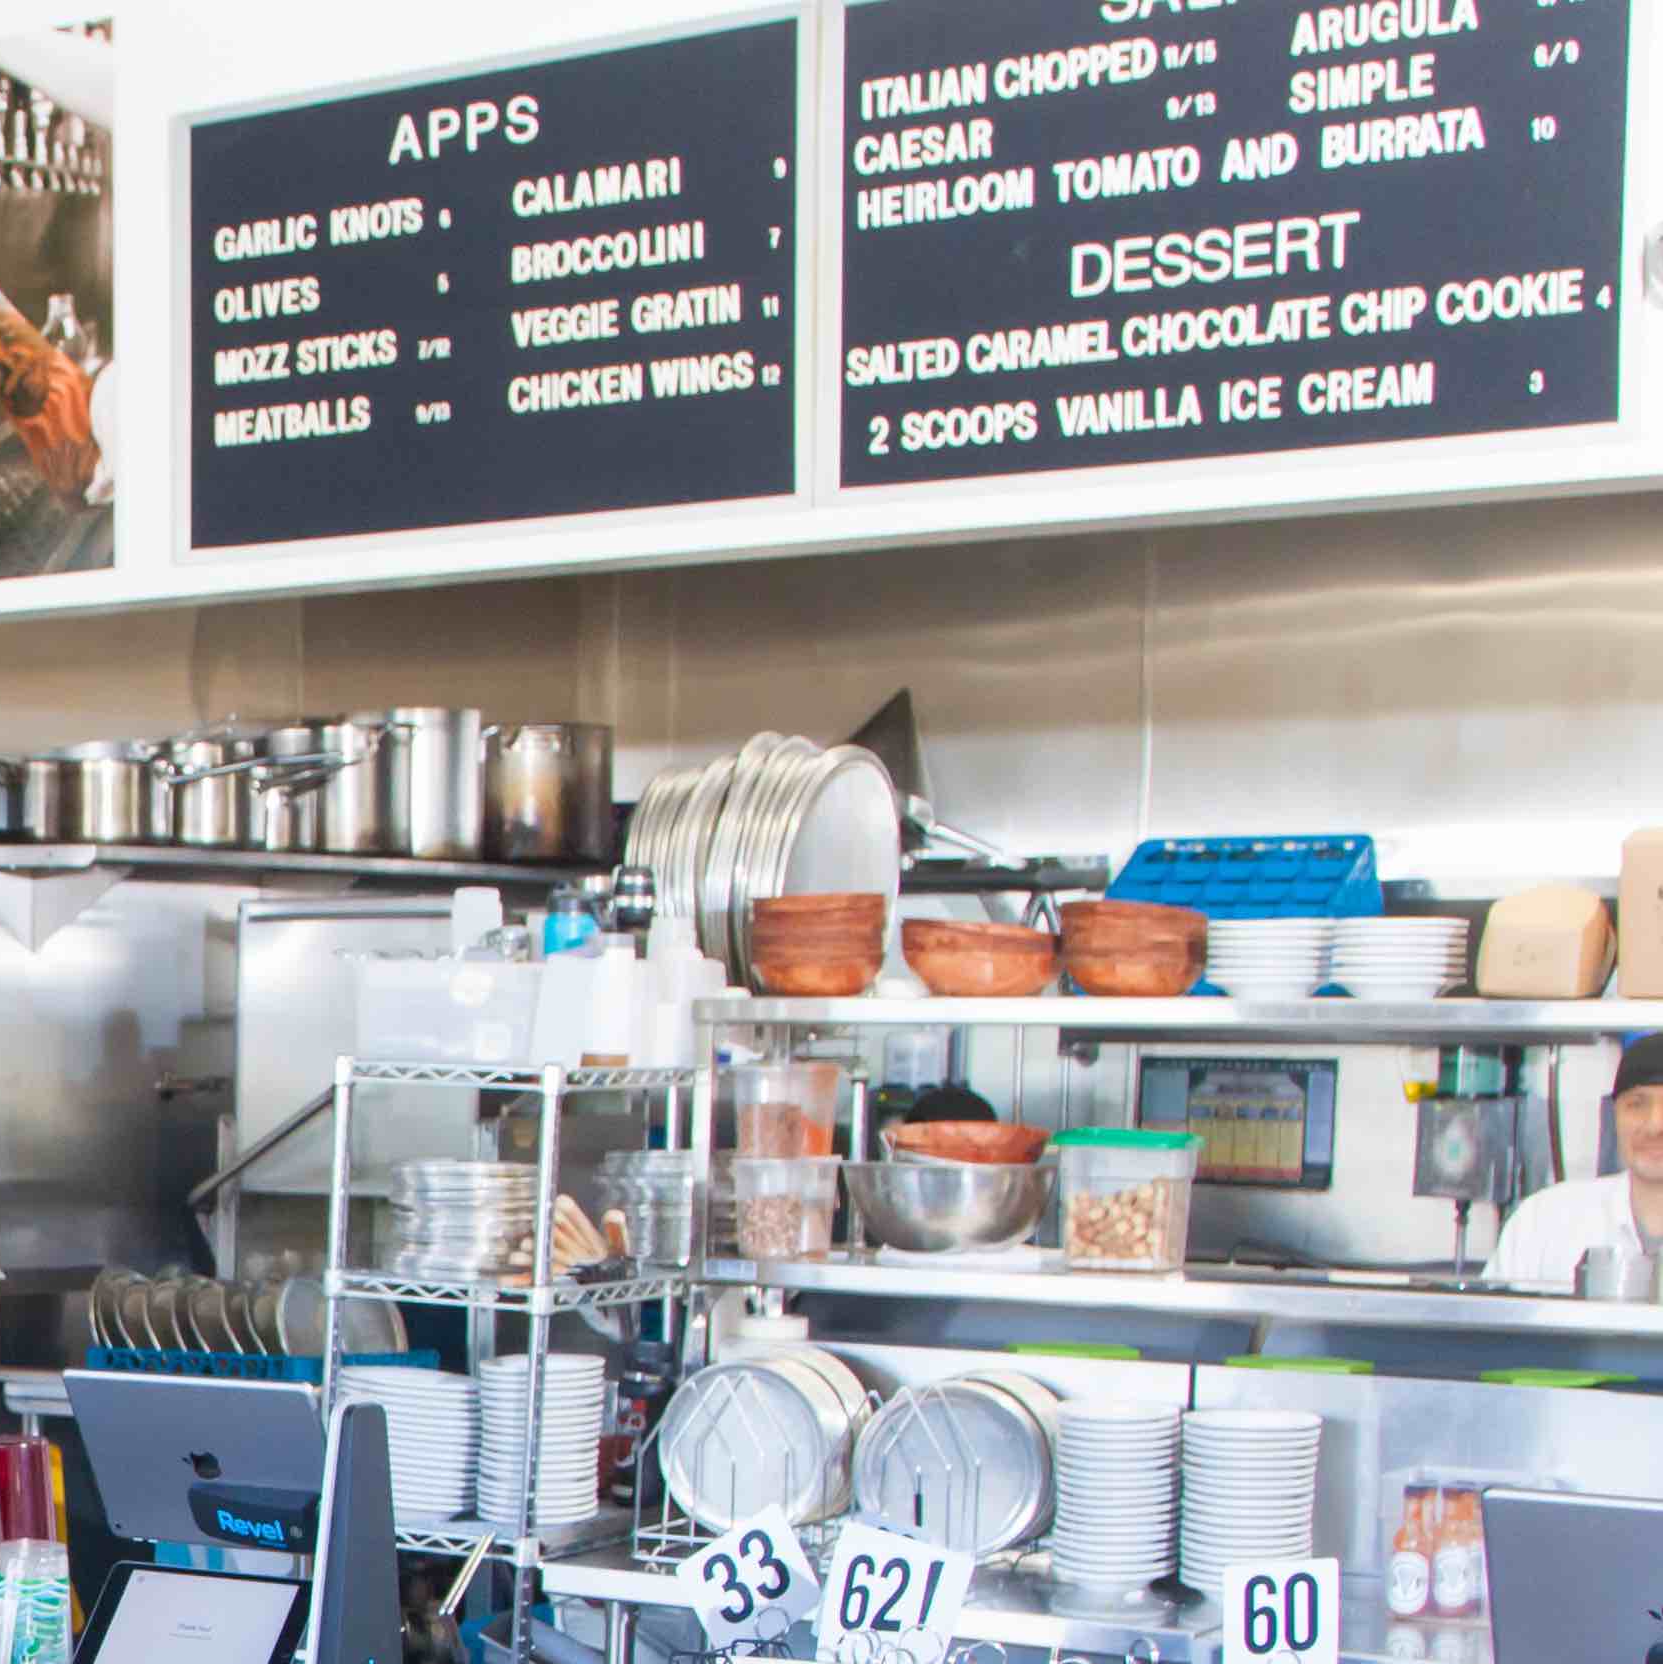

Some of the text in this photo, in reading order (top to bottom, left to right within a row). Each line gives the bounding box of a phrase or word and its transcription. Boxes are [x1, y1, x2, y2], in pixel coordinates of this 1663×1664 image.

[1289, 0, 1480, 57] ARUGULA
[860, 61, 987, 122] ITALIAN
[993, 36, 1158, 101] CHOPPED
[1288, 52, 1436, 115] SIMPLE
[388, 95, 540, 165] APPS
[853, 118, 994, 176] CAESAR
[511, 156, 682, 217] CALAMARI
[857, 106, 1557, 230] HEIRLOOM TOMATO AND BURRATA 10
[214, 214, 318, 261] GARLIC
[329, 198, 423, 245] KNOTS
[511, 220, 782, 284] BROCCOLINI 7
[1070, 210, 1361, 298] DESSERT
[214, 276, 320, 323] OLIVES
[511, 299, 620, 349] VEGGIE
[630, 283, 742, 335] GRATIN
[845, 268, 1612, 387] SALTED CARAMEL CHOCOLATE CHIP COOKIE 4
[214, 343, 290, 387] MOZZ
[295, 329, 398, 374] STICKS
[507, 360, 644, 415] CHICKEN
[650, 350, 755, 399] WINGS
[214, 395, 372, 448] MEATBALLS
[868, 360, 1545, 455] 2 SCOOPS VANILLA ICE CREAM 3
[216, 1510, 284, 1541] Revel
[703, 1528, 791, 1624] 33
[1244, 1572, 1319, 1655] 60
